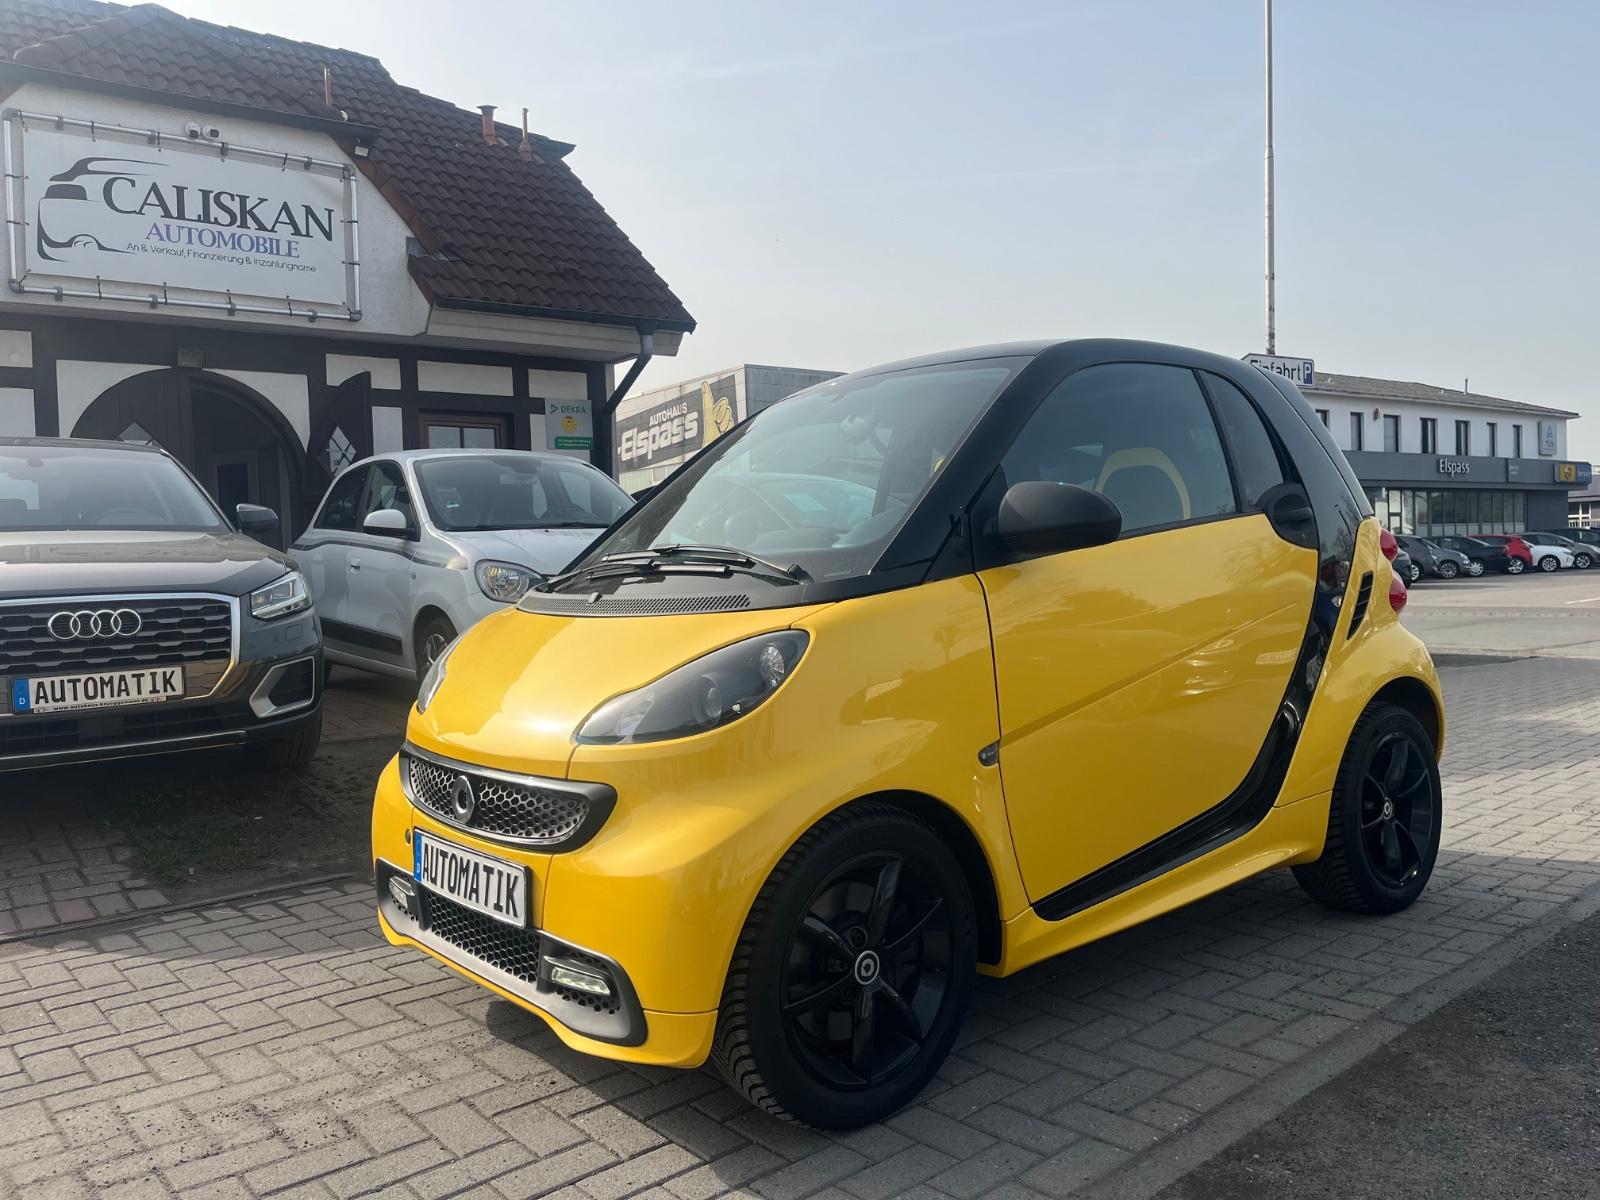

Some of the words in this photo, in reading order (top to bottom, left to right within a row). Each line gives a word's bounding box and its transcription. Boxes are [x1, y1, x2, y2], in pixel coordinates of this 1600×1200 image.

[103, 176, 335, 242] CALISKAN
[126, 243, 140, 252] An
[141, 244, 148, 253] &
[187, 249, 244, 266] Finanzierung
[245, 257, 252, 265] &
[146, 222, 300, 259] AUTOMOBILE
[1304, 363, 1312, 380] P
[560, 405, 586, 414] DEKRA
[649, 402, 688, 426] AUTOHAUS
[620, 411, 698, 460] Elspass
[1439, 458, 1470, 477] Elspass
[19, 697, 25, 705] D
[35, 670, 177, 705] AUTOMATIK
[416, 862, 421, 874] D
[422, 843, 519, 918] AUTOMATIK
